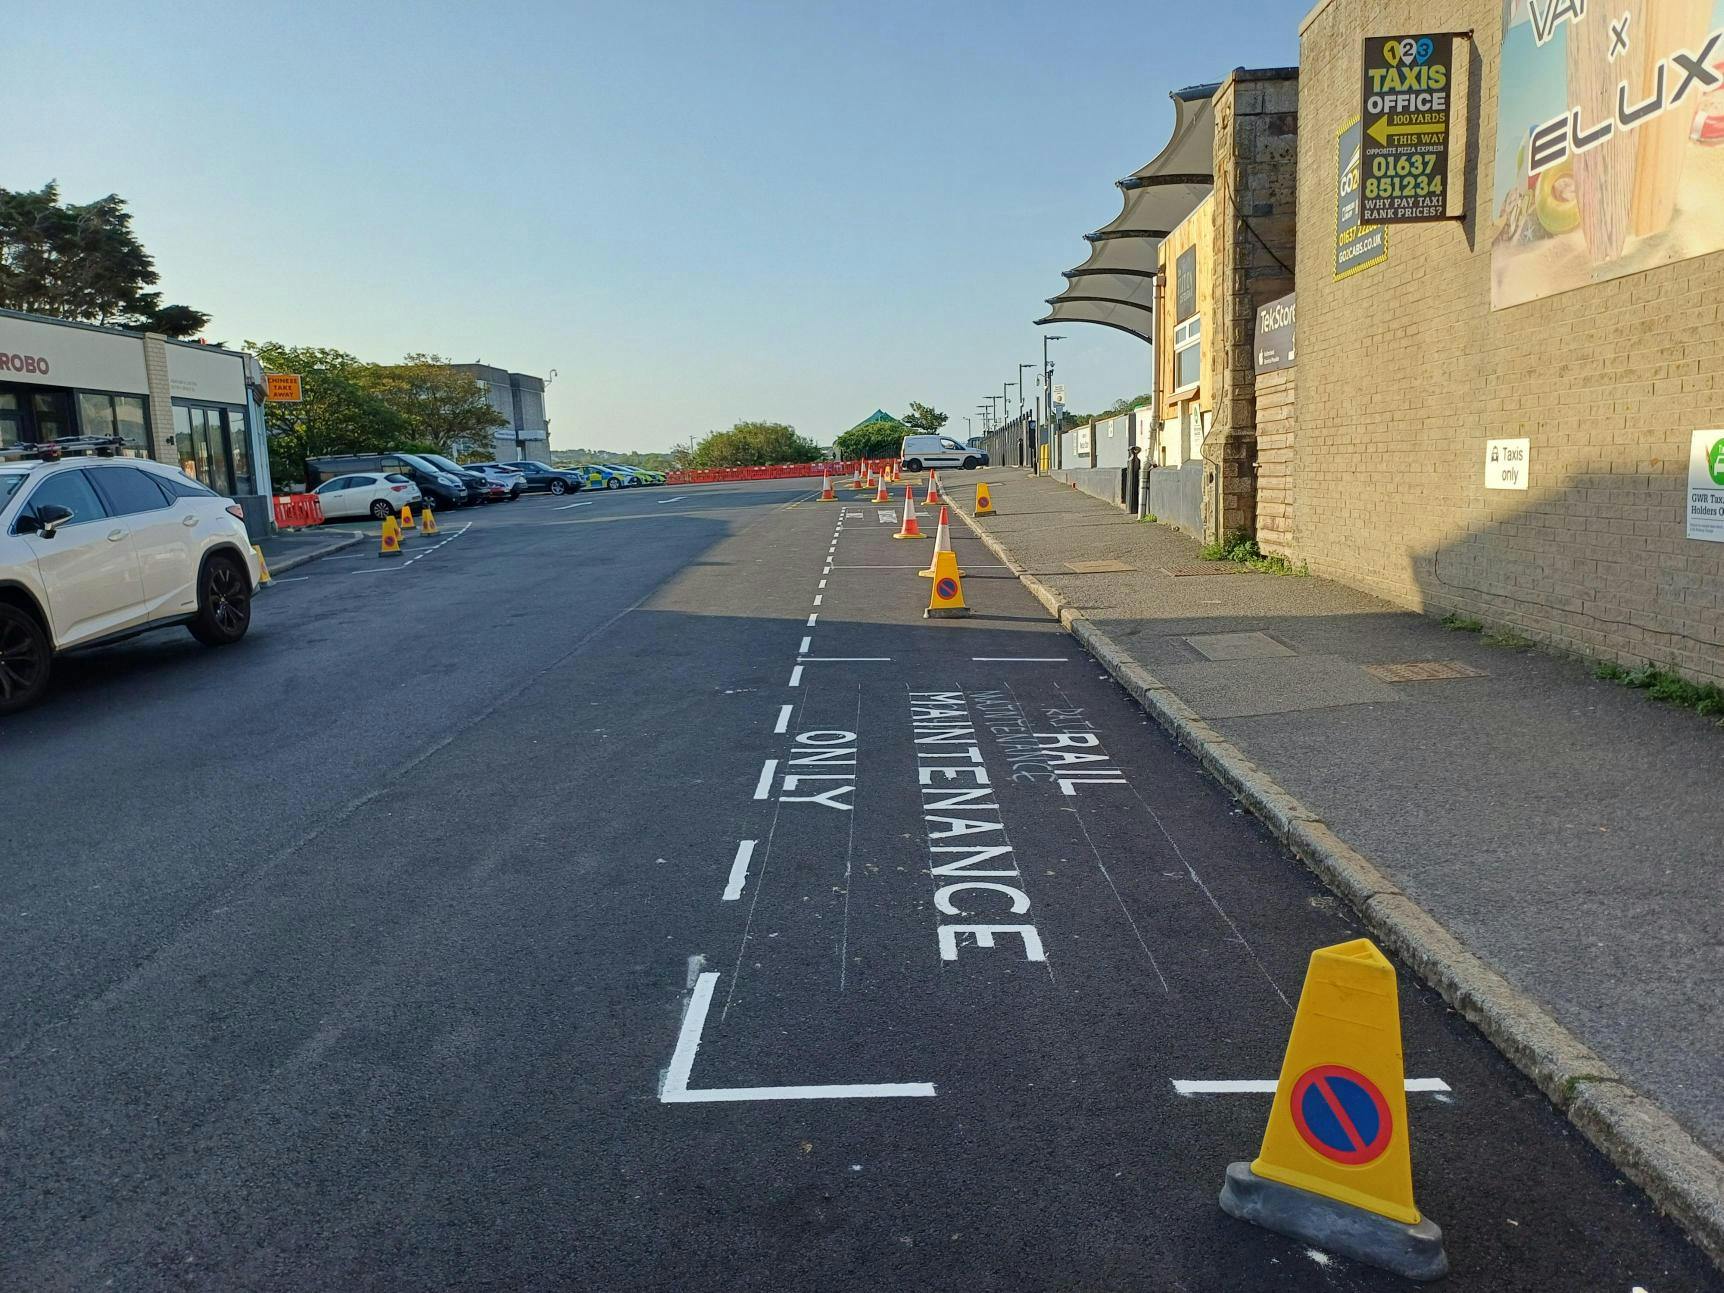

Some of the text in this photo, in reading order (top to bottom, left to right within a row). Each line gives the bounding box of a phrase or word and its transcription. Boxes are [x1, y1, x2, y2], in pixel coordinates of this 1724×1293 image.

[1529, 0, 1585, 42] VA
[1368, 64, 1447, 93] TAXIS
[1367, 92, 1446, 114] OFFICE
[1530, 32, 1723, 173] ELUX
[1393, 112, 1446, 124] 100 YARDS
[1366, 145, 1444, 155] OPPOSITE PIZZA EXPRESS
[1392, 133, 1445, 145] THIS WAY
[1372, 154, 1437, 177] 01637
[1365, 175, 1443, 198] 851234
[1364, 196, 1443, 209] WHY PAY TAXI
[1364, 209, 1395, 219] RANK
[1397, 207, 1443, 218] PRICES?
[1339, 226, 1357, 248] 01637
[1502, 446, 1524, 462] Taxis
[1501, 467, 1520, 485] only
[1691, 493, 1724, 504] GWR Tax
[1691, 505, 1717, 516] Holders
[779, 730, 858, 810] ONLY
[1033, 733, 1129, 796] RAIL
[909, 692, 1047, 962] MAINTENANCE
